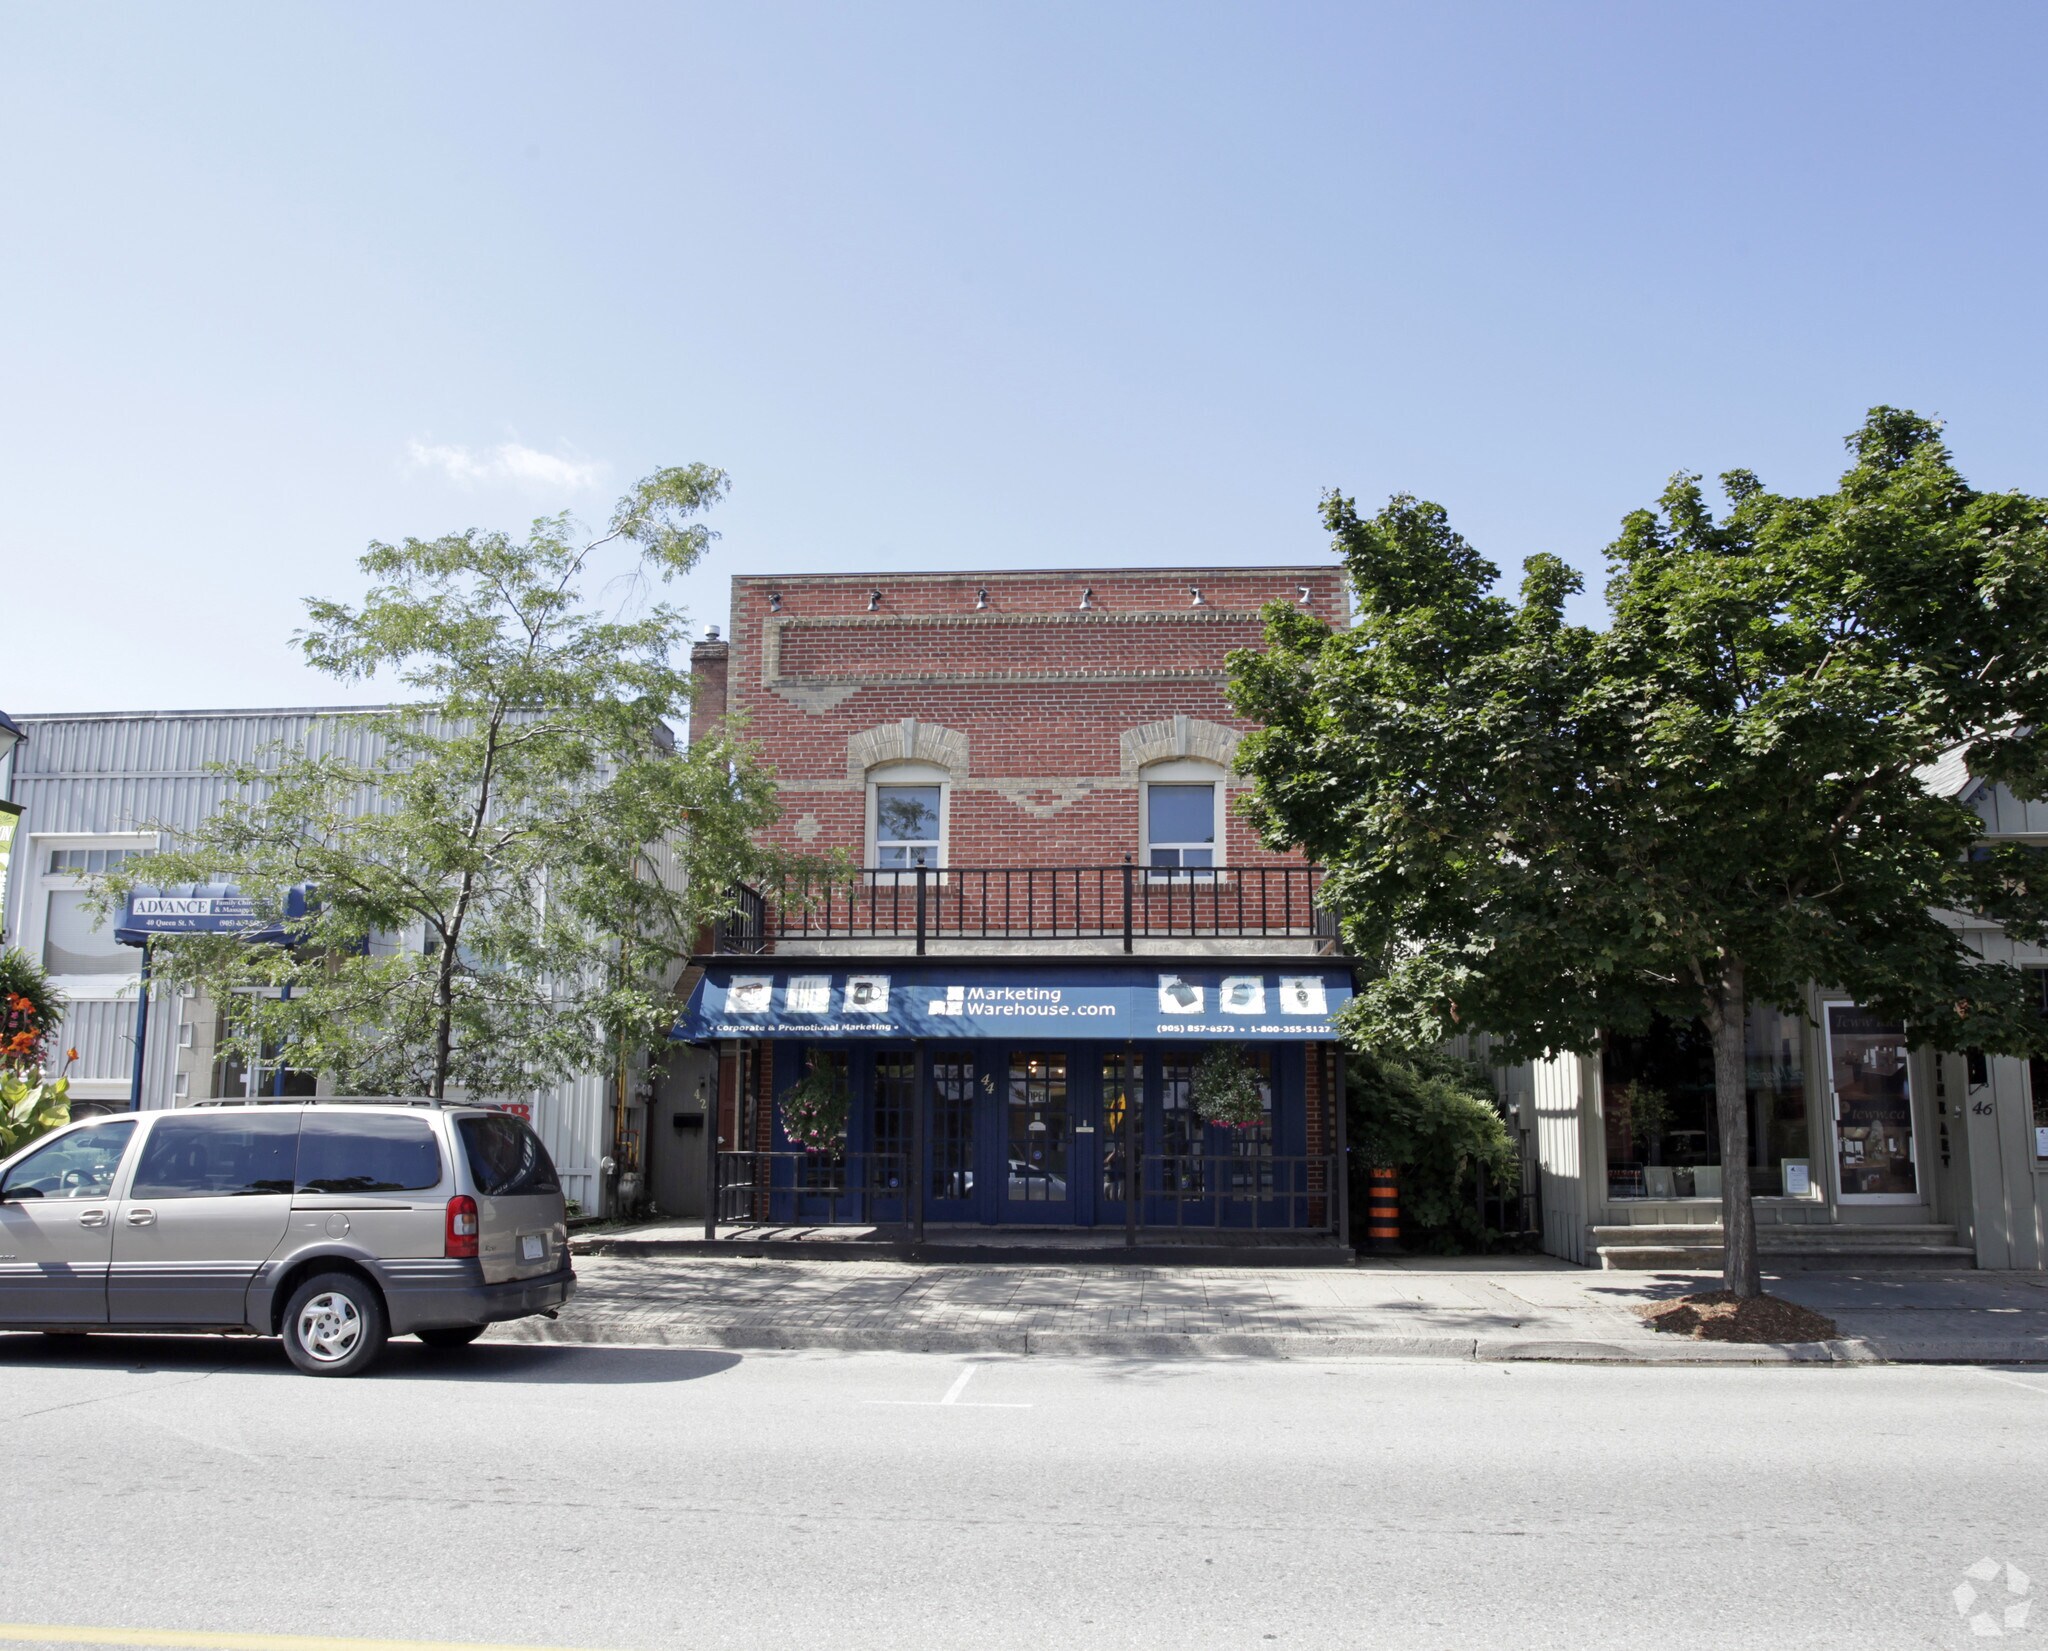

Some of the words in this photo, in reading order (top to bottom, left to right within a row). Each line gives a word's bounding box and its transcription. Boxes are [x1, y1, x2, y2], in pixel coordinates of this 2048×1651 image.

[136, 900, 208, 914] ADVANCE
[216, 899, 236, 907] Family
[214, 906, 220, 914] &
[155, 919, 176, 927] Queen
[219, 919, 235, 927] (905)
[968, 987, 1062, 1003] Marketing
[968, 1003, 1116, 1016] Warehouse.com
[716, 1024, 765, 1032] Corporate
[778, 1024, 838, 1032] Promotional
[841, 1023, 891, 1032] Marketing
[1156, 1024, 1185, 1034] (905)
[1250, 1025, 1331, 1034] 1-800-355-5127
[980, 1073, 995, 1095] 44
[693, 1088, 707, 1109] 42
[1972, 1101, 1993, 1116] 46
